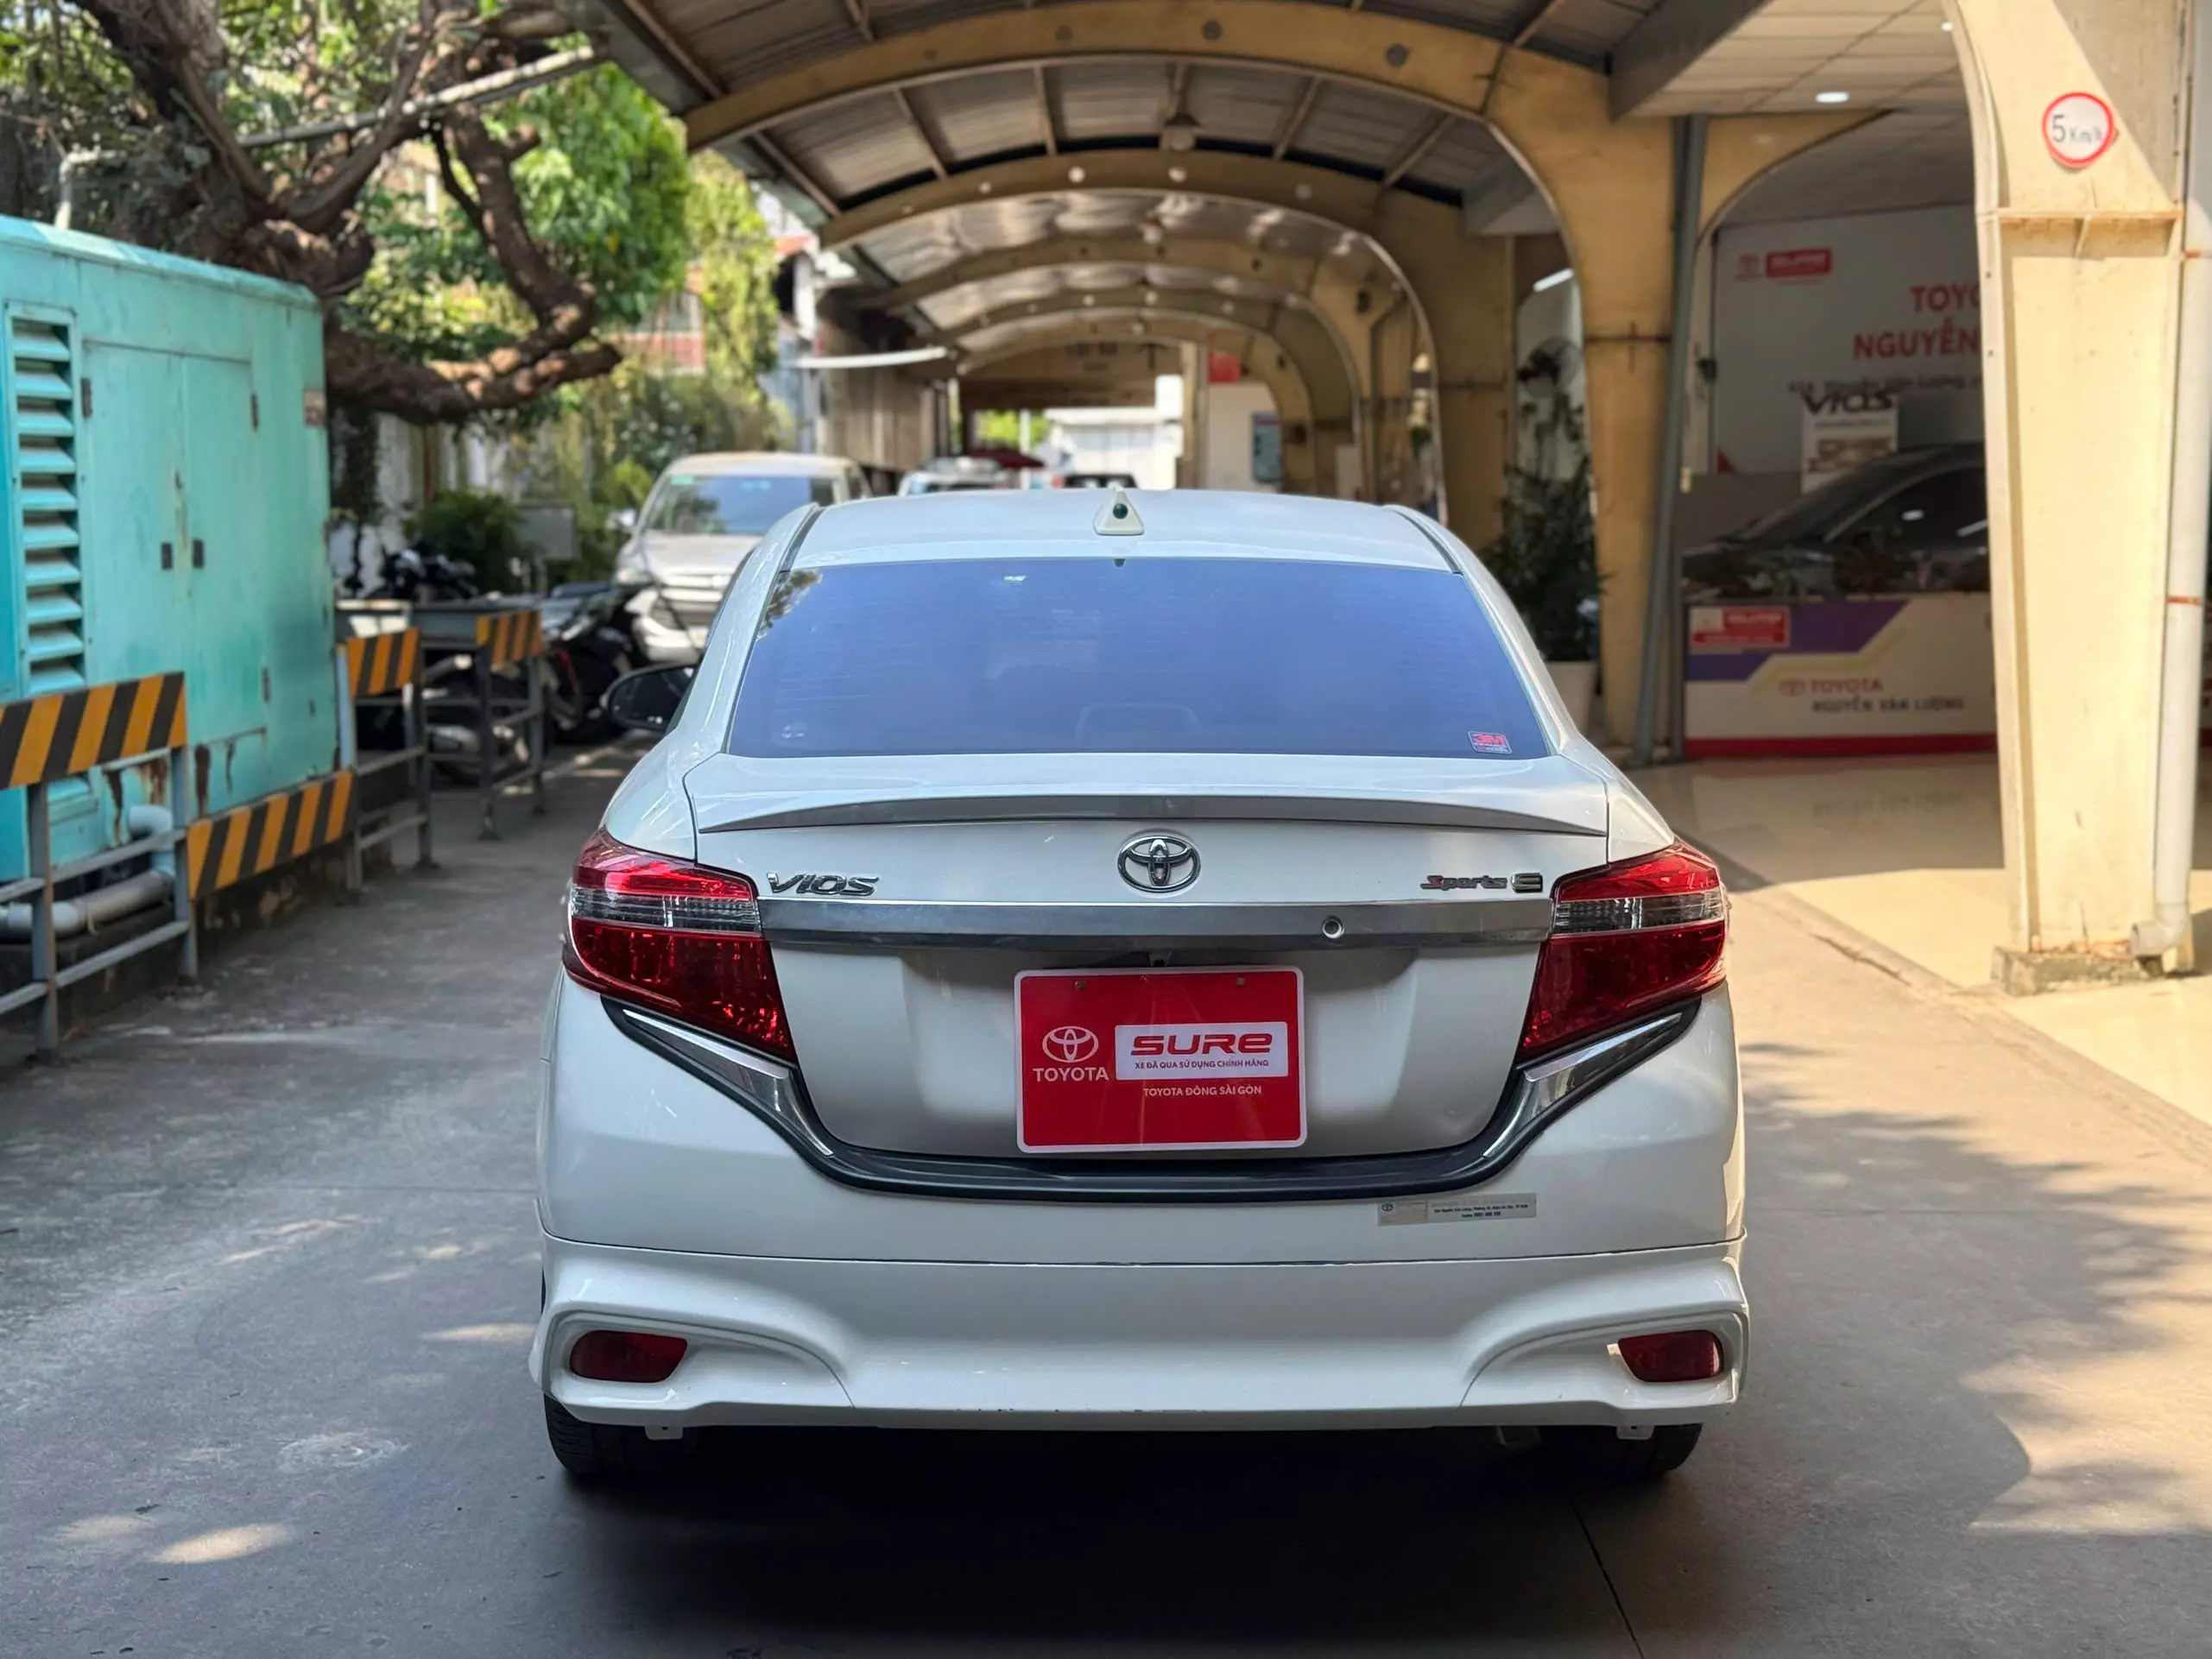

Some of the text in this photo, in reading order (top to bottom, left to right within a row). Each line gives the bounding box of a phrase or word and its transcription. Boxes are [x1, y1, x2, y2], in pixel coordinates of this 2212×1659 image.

[767, 873, 879, 896] VIOS
[1420, 874, 1507, 891] Sports
[1147, 1060, 1159, 1069] ĐÃ
[1179, 1058, 1191, 1069] SỬ
[1191, 1060, 1216, 1069] DỤNG
[1217, 1058, 1243, 1068] CHÍNH
[1245, 1058, 1269, 1067] HÀNG
[1032, 1067, 1109, 1082] TOYOTA
[1143, 1084, 1262, 1097] TOYOTA ĐÔNG SÀI GÒN
